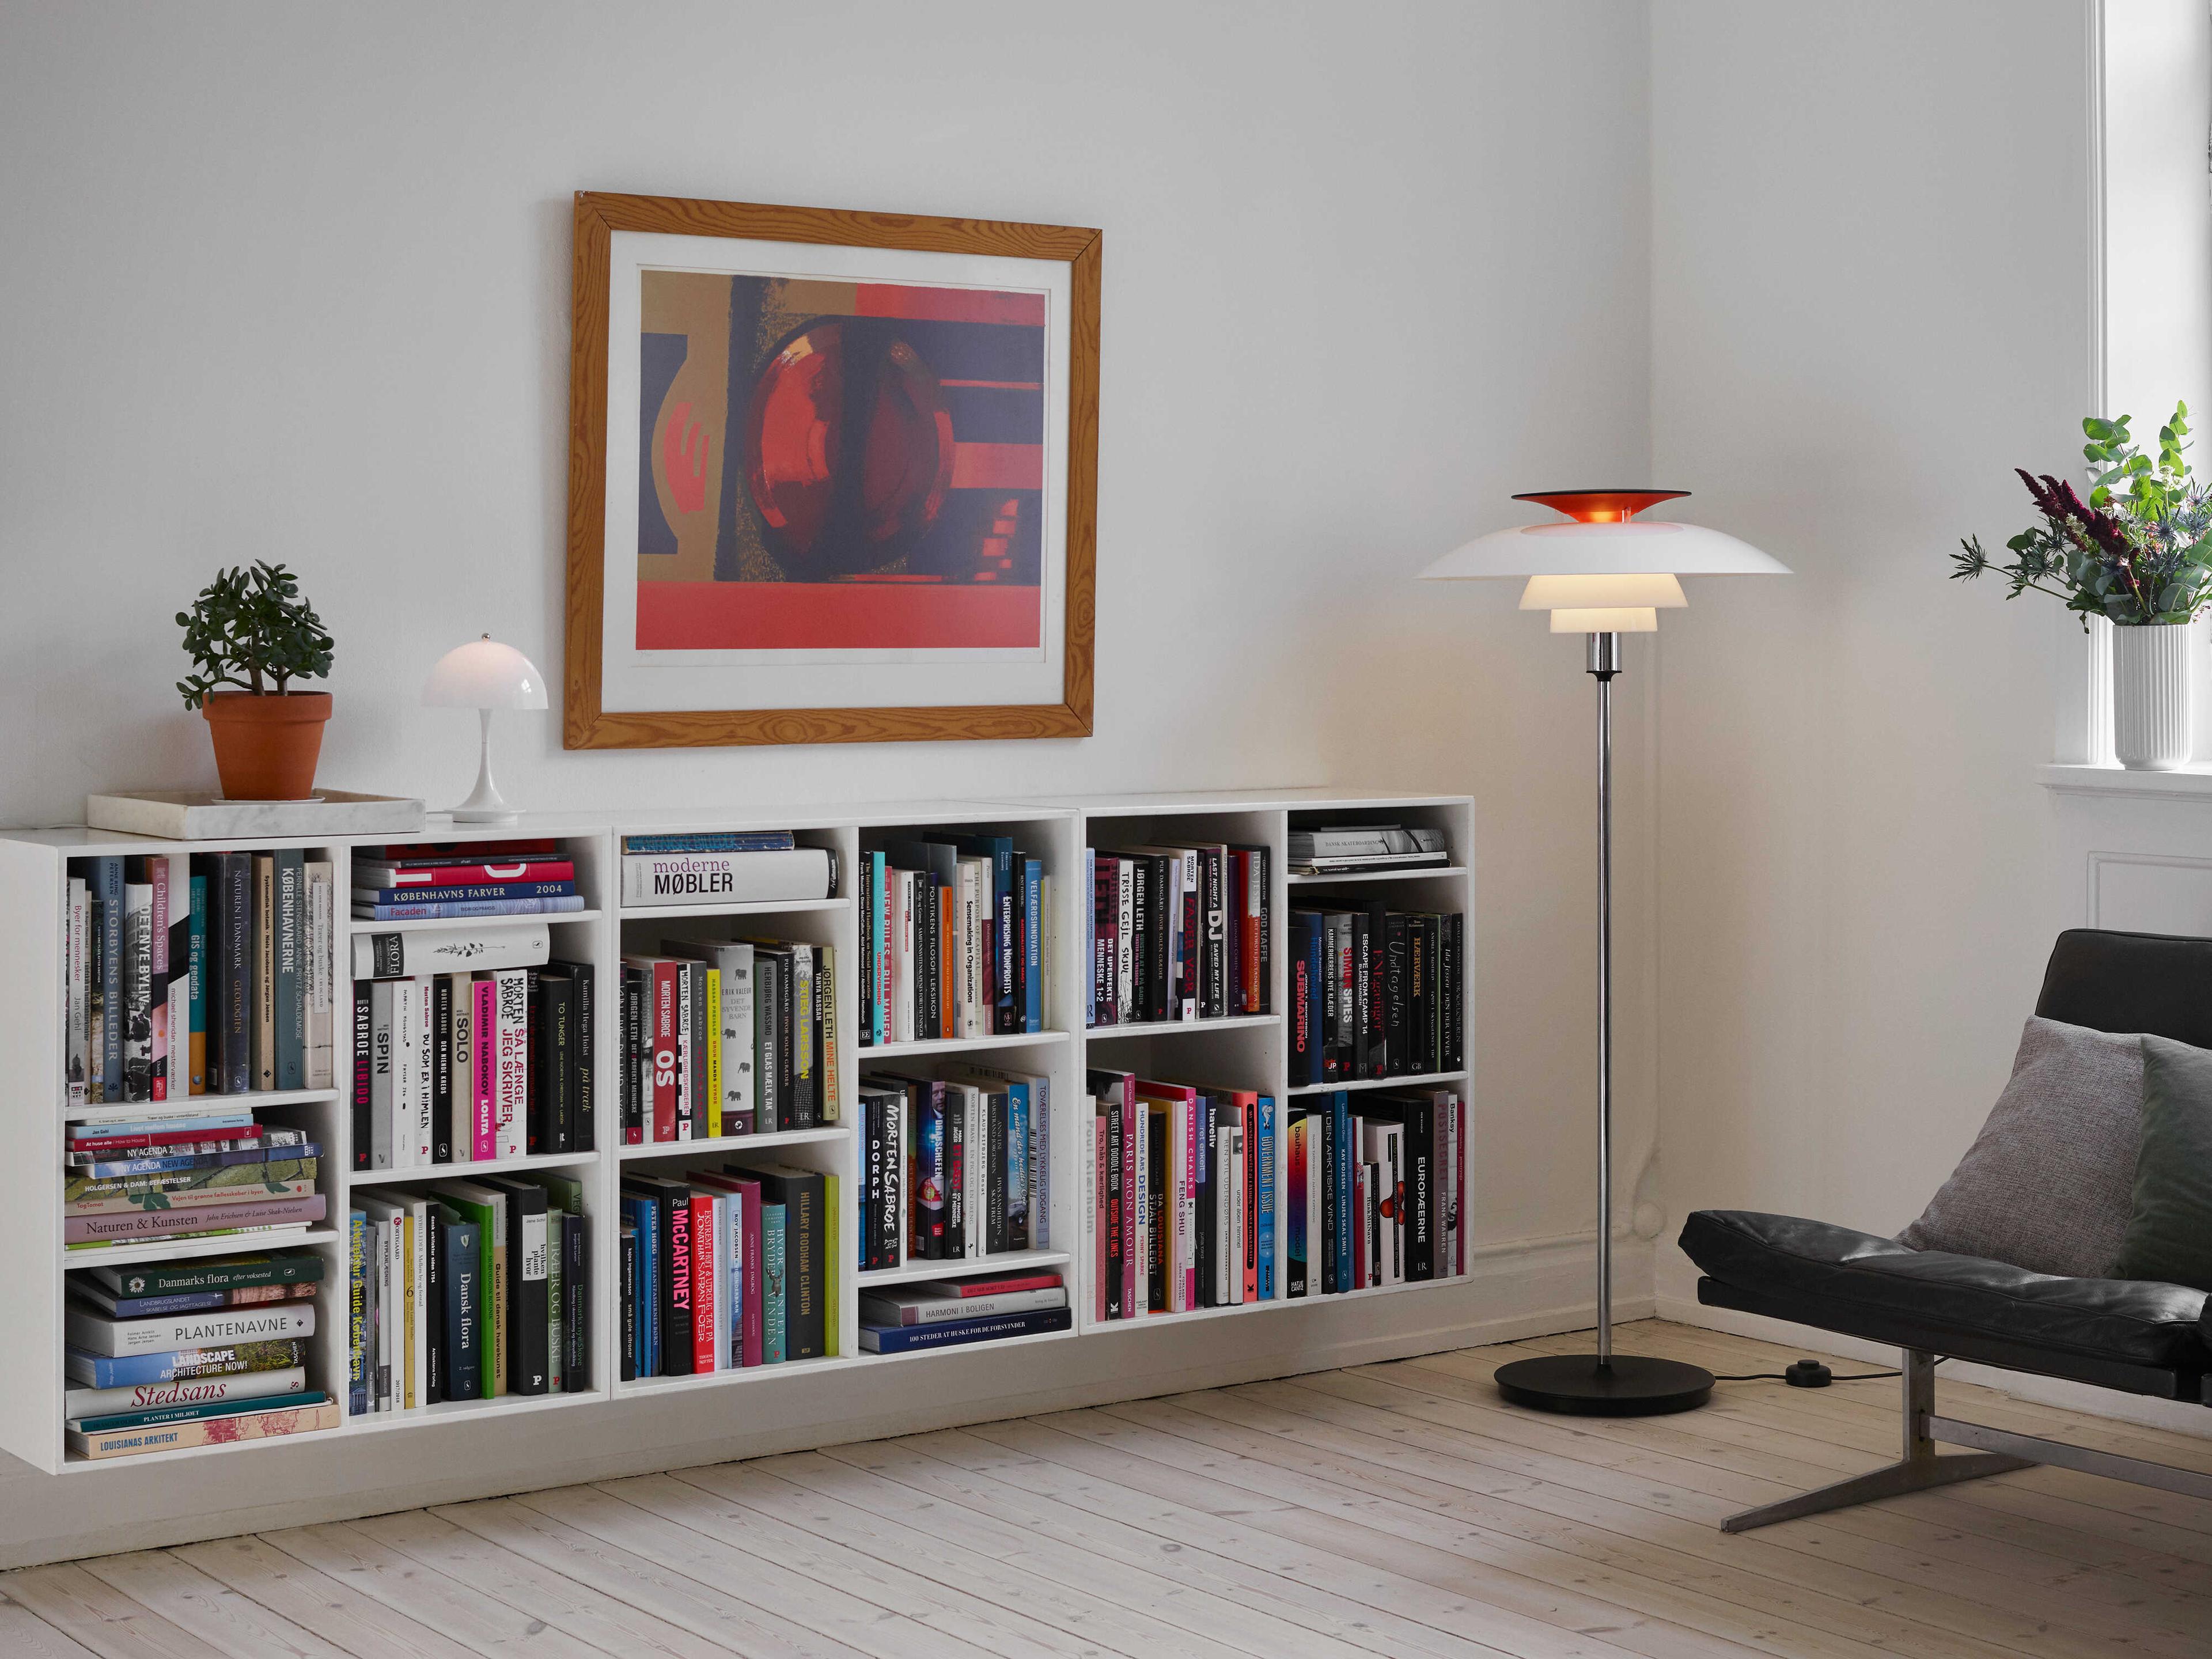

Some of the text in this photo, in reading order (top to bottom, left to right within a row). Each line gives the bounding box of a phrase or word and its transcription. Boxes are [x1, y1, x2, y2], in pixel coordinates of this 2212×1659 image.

[653, 857, 730, 873] moderne
[654, 873, 733, 895] MØBLER
[390, 907, 427, 916] Facaden
[394, 885, 562, 902] KØBENHAVNS FARVER 2004
[1135, 868, 1145, 931] JØRGEN LETH
[155, 882, 166, 970] Children's Spaces
[282, 868, 294, 974] KØBENHAVNERNE
[1002, 896, 1013, 994] ENTERPRISING NONPROFITS
[1030, 880, 1038, 966] VELFÆRDSINNOVATION
[1208, 910, 1222, 940] DJ
[138, 906, 150, 1002] DET NYE BYLIV
[1214, 969, 1219, 981] MY
[108, 899, 119, 1061] STORBYENS BILLEDER
[764, 967, 772, 1003] HERBJØRG
[1342, 948, 1353, 1023] SIMON SPIES
[1387, 941, 1406, 1028] Undtagelsen
[1296, 960, 1305, 1053] SUBMARINO
[1361, 1025, 1368, 1035] 14
[357, 1006, 369, 1104] SABROE LIBIDO
[377, 1033, 389, 1074] SPIN
[456, 1018, 468, 1063] SOLO
[656, 980, 675, 1087] MORTEN SABROE OS
[765, 1042, 772, 1050] ET
[823, 965, 836, 1102] JØRGEN LETH MINE HELTE
[502, 1029, 513, 1123] JEG SKRIVER
[514, 1028, 527, 1105] SÅ LÆNGE
[579, 1067, 592, 1112] på træk
[764, 1072, 772, 1096] MÆLK,
[480, 1099, 488, 1136] LOLITA
[139, 1146, 168, 1156] AGENDA
[934, 1119, 944, 1177] DRABSCHEFEN
[85, 1182, 122, 1192] HOLGERSEN
[130, 1180, 147, 1188] DAM:
[149, 1176, 191, 1187] BEFÆSTELSER
[1109, 1110, 1119, 1258] STREET ART DOODLE BOOK OUTSIDE THE LINES
[1126, 1133, 1134, 1267] PARIS MON AMOUR
[1157, 1194, 1164, 1207] DA
[1261, 1136, 1274, 1214] GOVERNMENT ISSUE
[1418, 1156, 1426, 1243] EUROPÆERNE
[86, 1215, 198, 1234] Naturen & Kunsten
[1149, 1194, 1157, 1276] STJAL BILLEDET
[532, 1251, 540, 1275] plante
[672, 1209, 690, 1310] McCARTNEY
[800, 1192, 810, 1316] HILLARY RODHAM CLINTON
[158, 1274, 229, 1289] Danmarks flora
[351, 1220, 363, 1380] Arkitektur Guide København
[551, 1238, 561, 1363] TRÆER OG BUSKE
[175, 1317, 287, 1340] PLANTENAVNE
[460, 1272, 472, 1350] Dansk flora
[926, 1308, 959, 1318] HARMONI
[965, 1303, 995, 1313] BOLIGEN
[160, 1360, 248, 1379] ARCHITECTURE NOW!
[173, 1350, 236, 1367] LANDSCAPE
[130, 1381, 227, 1407] Stedsans
[100, 1432, 179, 1451] LOUISIANAS ARKITEKT
